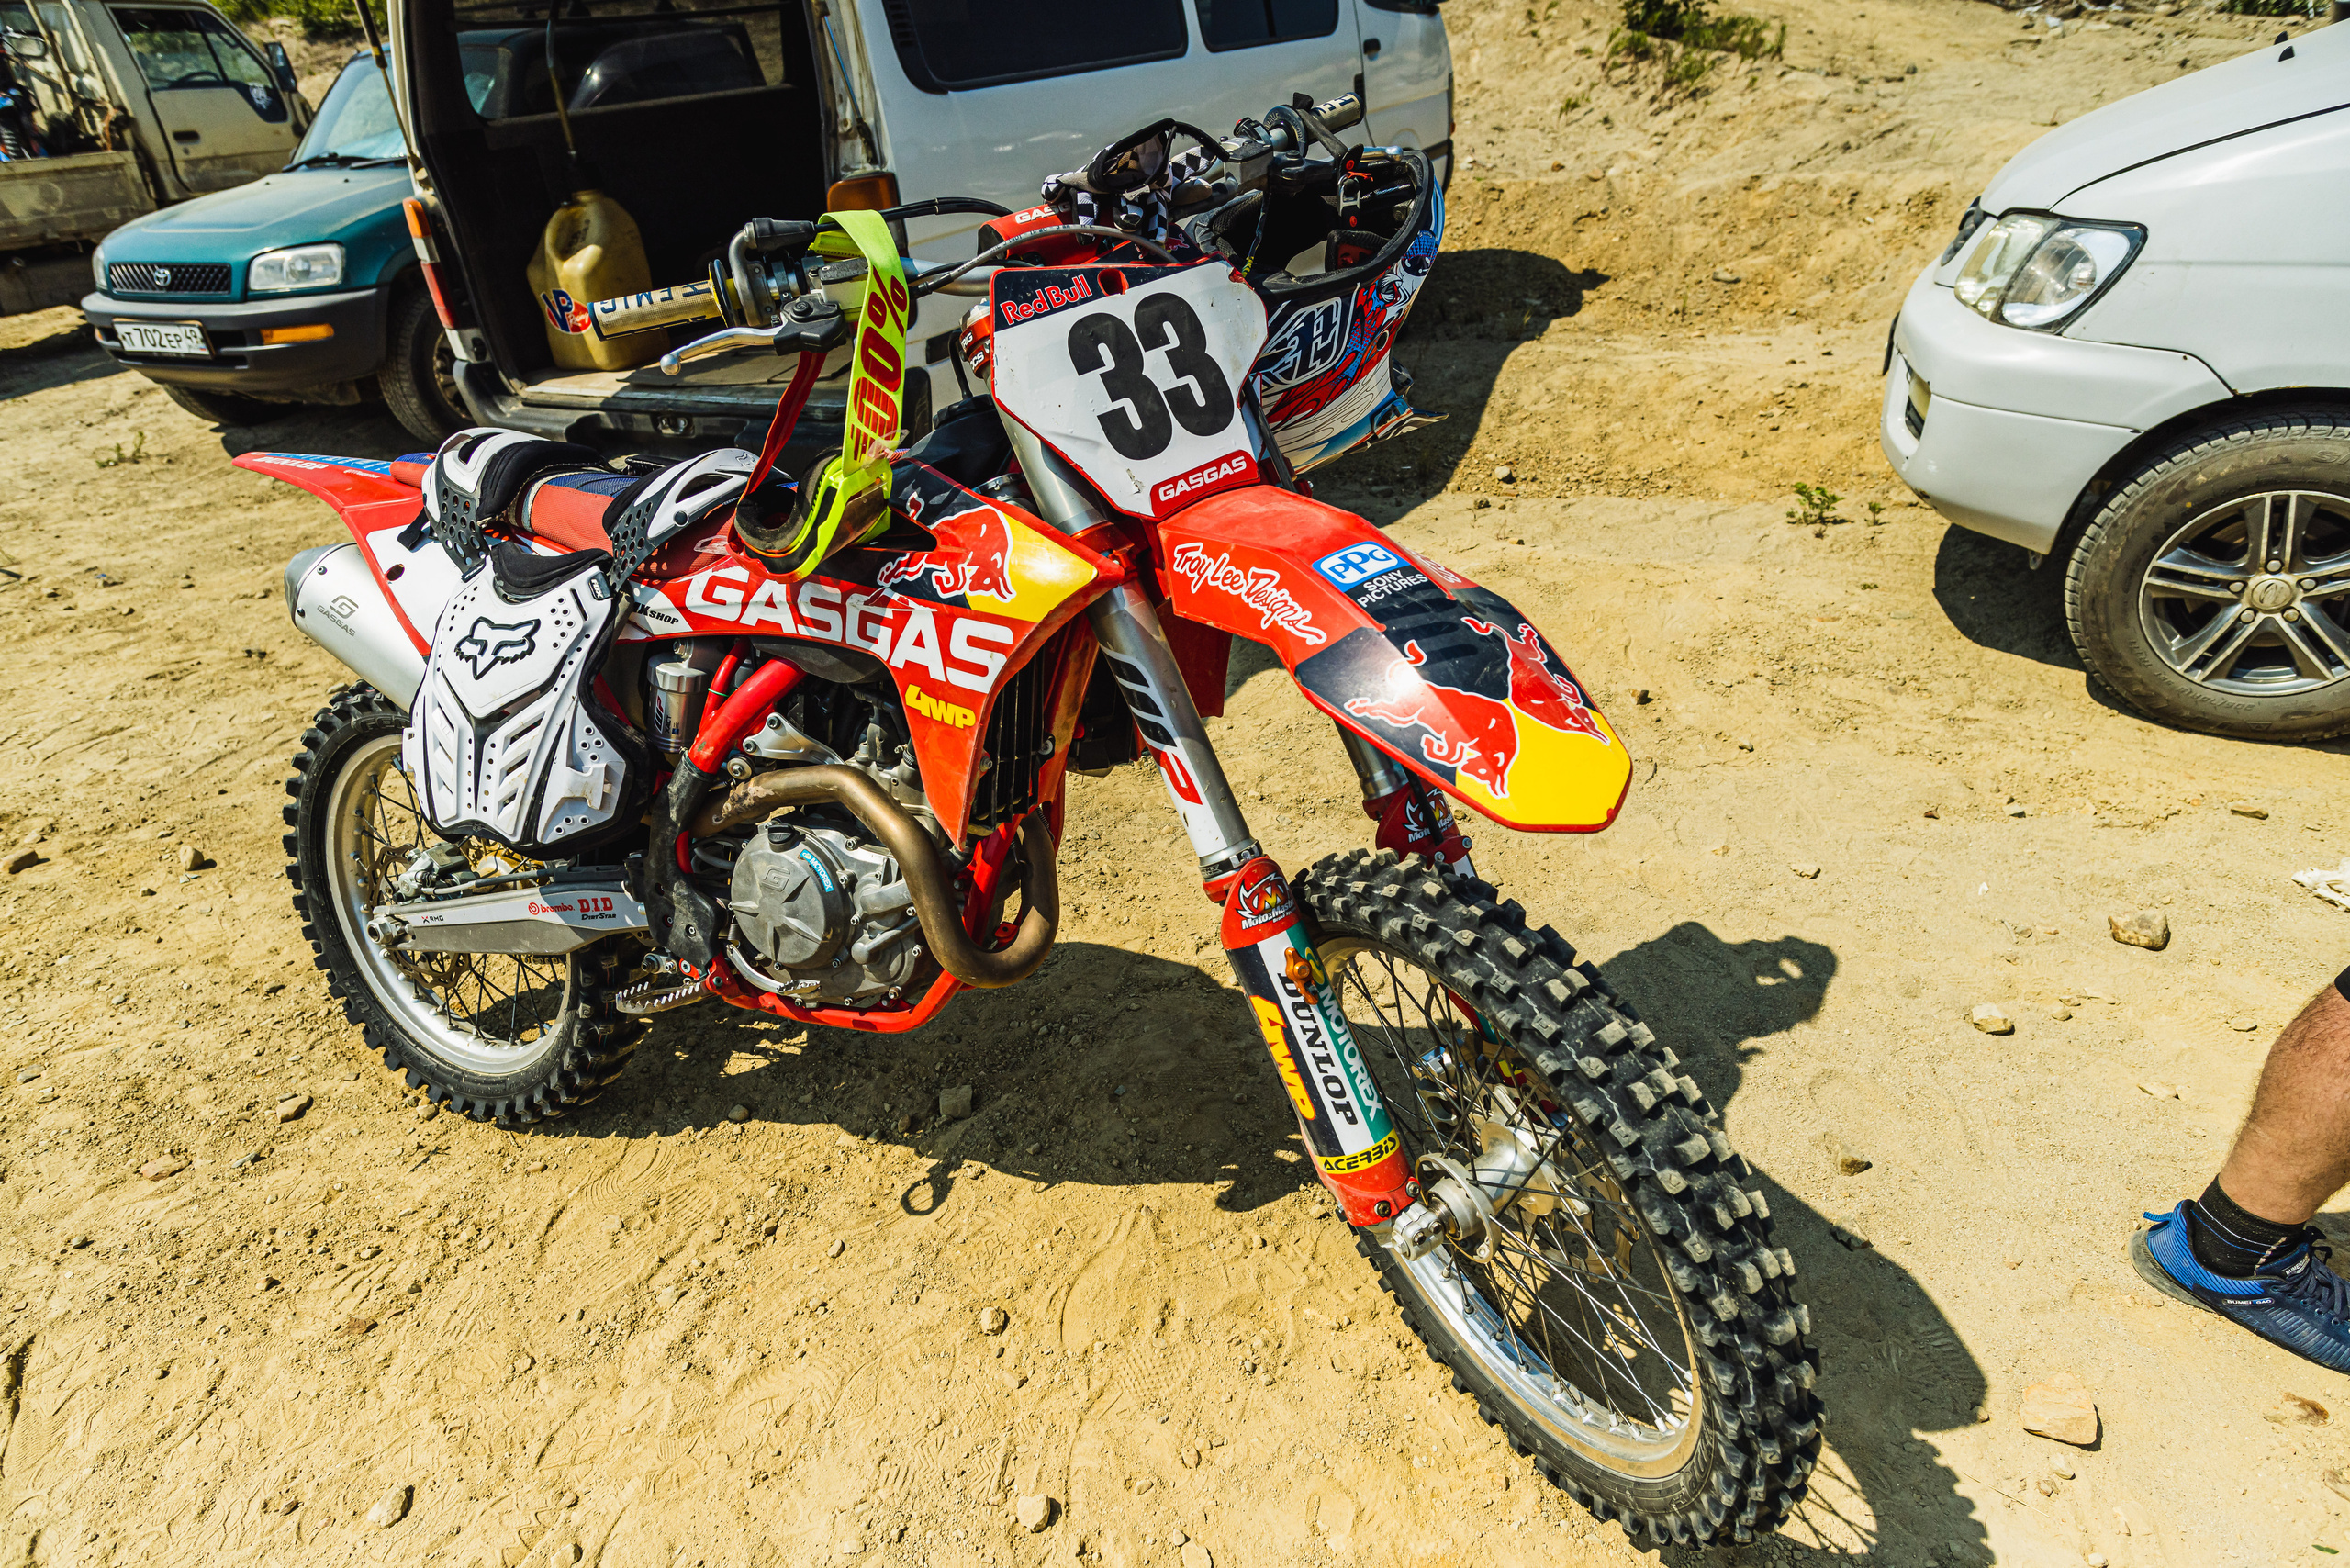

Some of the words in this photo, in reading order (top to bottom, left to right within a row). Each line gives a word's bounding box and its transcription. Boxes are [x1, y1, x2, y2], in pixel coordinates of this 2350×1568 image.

[541, 288, 573, 333] VP
[1000, 289, 1050, 325] Red
[1045, 274, 1092, 309] Bull
[1068, 292, 1235, 461] 33
[253, 456, 329, 470] DUNLOP
[1158, 455, 1248, 502] GASGAS
[1328, 549, 1391, 580] PPG
[1363, 569, 1404, 592] SONY
[1173, 543, 1213, 593] Troy
[1208, 553, 1246, 595] Lee
[1243, 567, 1327, 644] Designs
[1357, 573, 1428, 609] PICTURES
[317, 605, 356, 637] GASGAS
[686, 566, 1013, 694] GASGAS
[809, 857, 833, 890] MOTOREX
[1278, 973, 1358, 1126] DUNLOP
[1318, 987, 1384, 1122] MOTOREX
